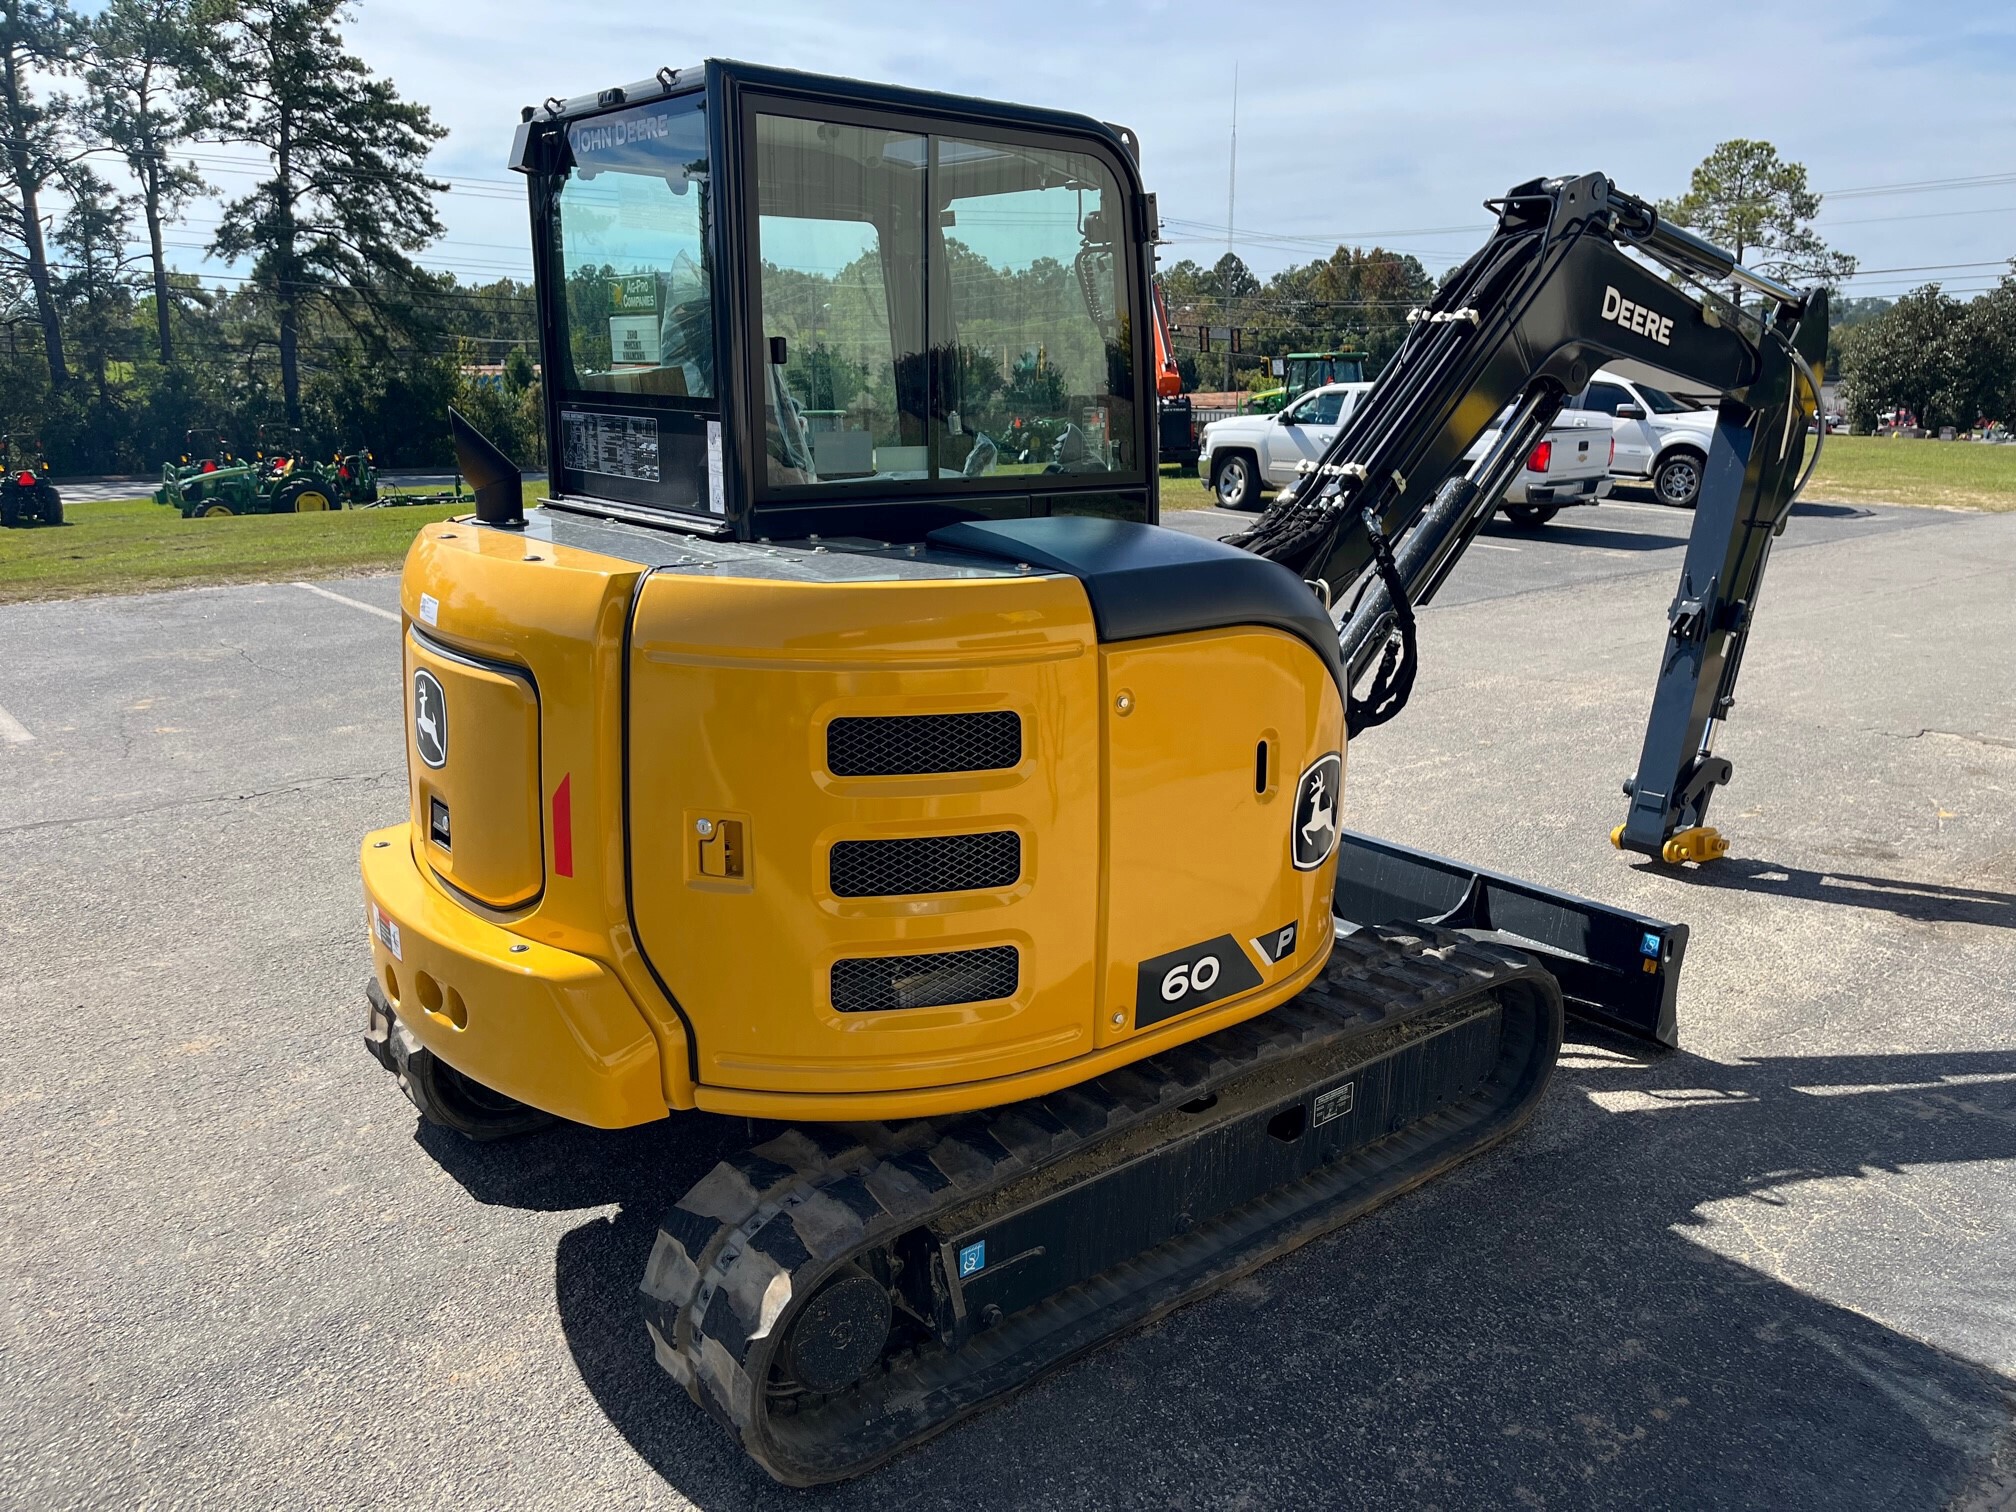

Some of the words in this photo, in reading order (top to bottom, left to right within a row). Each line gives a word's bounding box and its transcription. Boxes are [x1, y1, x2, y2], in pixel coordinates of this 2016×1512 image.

[571, 126, 612, 154] JOHN
[615, 114, 669, 146] DEERE
[623, 294, 655, 308] COMPANIES
[1601, 285, 1674, 346] DEERE
[1161, 955, 1221, 1001] 60
[1275, 926, 1295, 959] P
